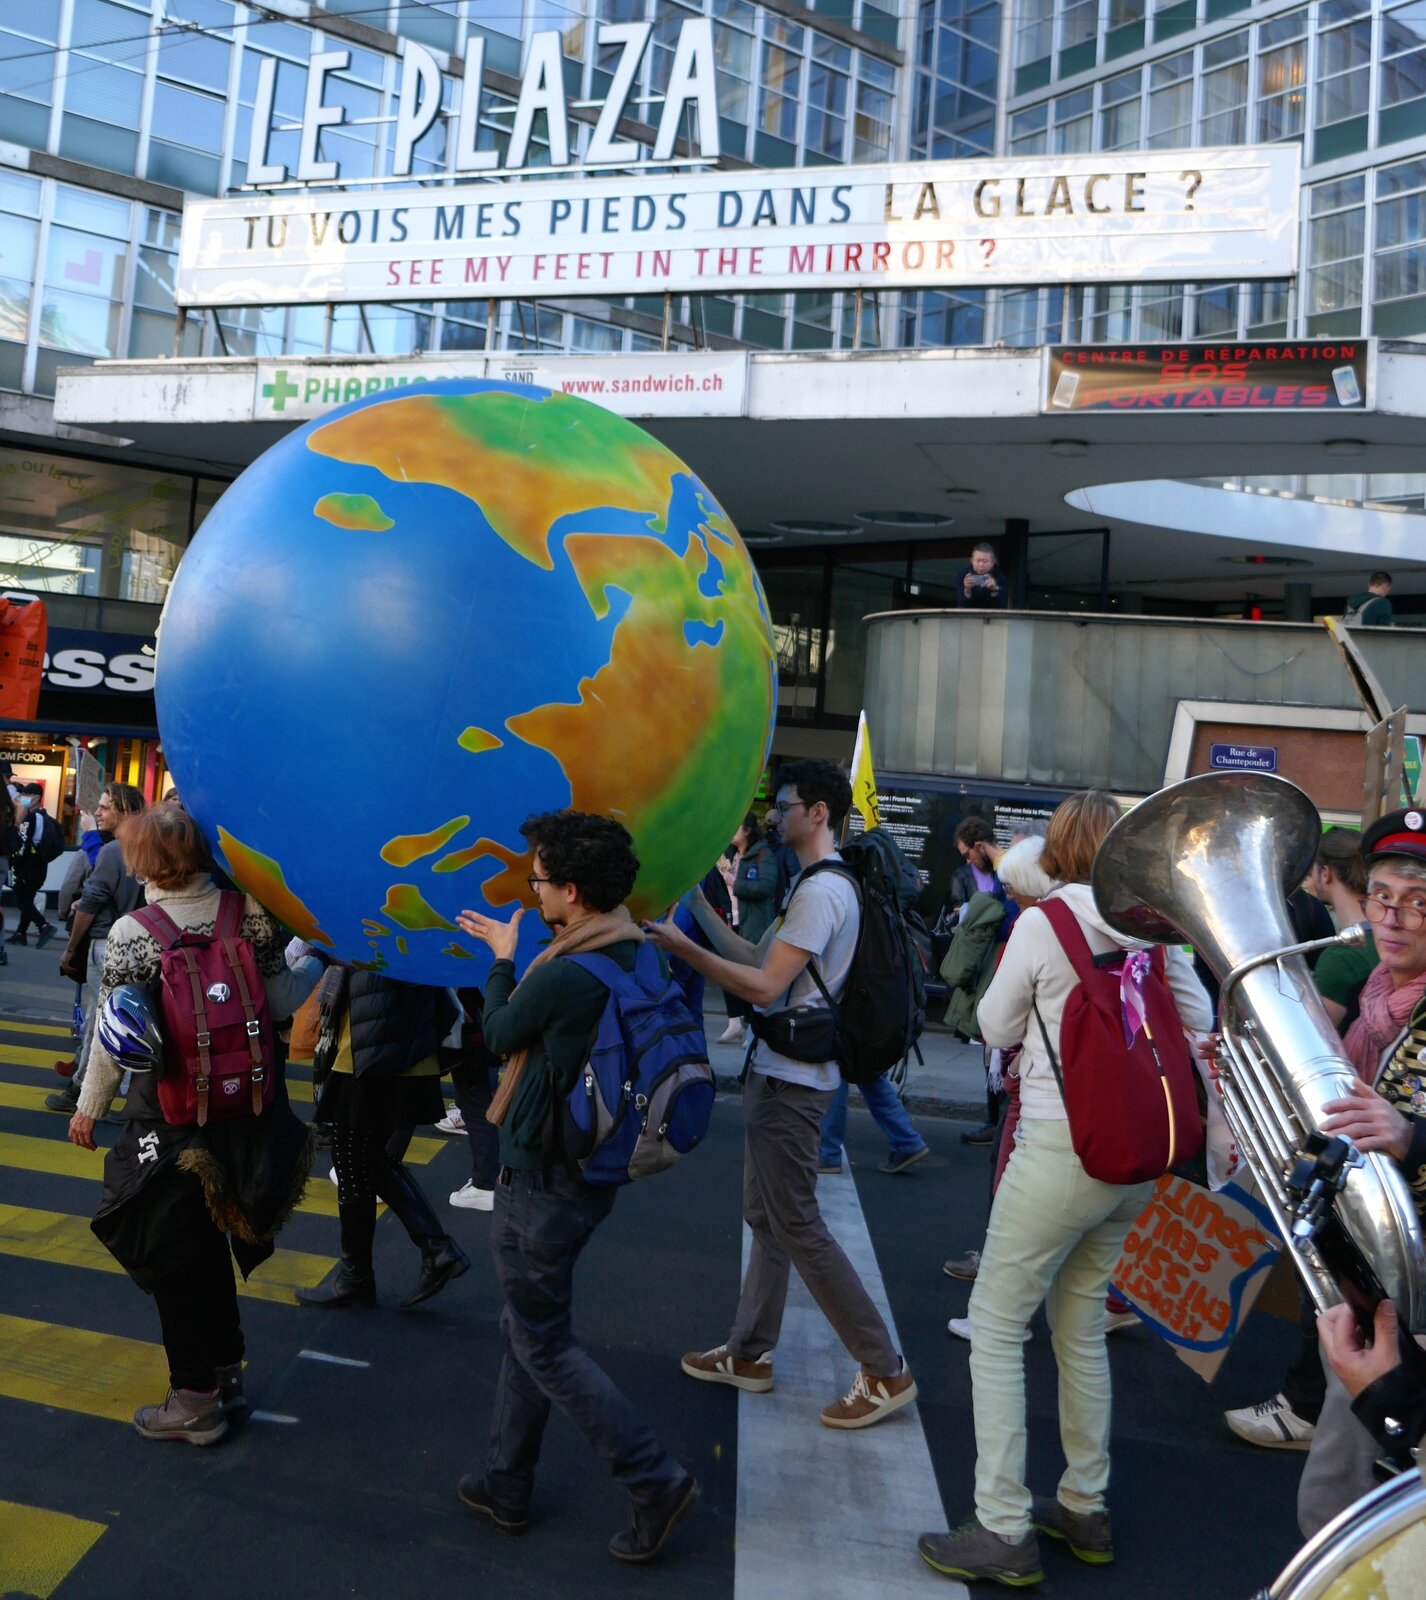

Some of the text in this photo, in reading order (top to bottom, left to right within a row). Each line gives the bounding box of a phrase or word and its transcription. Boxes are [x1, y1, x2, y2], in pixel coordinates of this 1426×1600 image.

[246, 18, 721, 185] LE PLAZA
[244, 169, 1203, 251] TU VOIS MES PIEDS DANS LA GLACE ?
[386, 238, 998, 287] SEE MY FEET IN THE MIRROR ?
[1061, 346, 1356, 365] CENTRE DE RÉPARATION
[504, 371, 534, 385] SAND
[561, 373, 723, 394] www.sandwich.ch
[1158, 363, 1250, 384] SOS
[303, 375, 478, 404] PHARM
[1079, 385, 1329, 408] PORTABLES
[17, 753, 46, 763] FORD
[1215, 755, 1270, 767] Chantepoulet
[1230, 747, 1257, 758] Rue de
